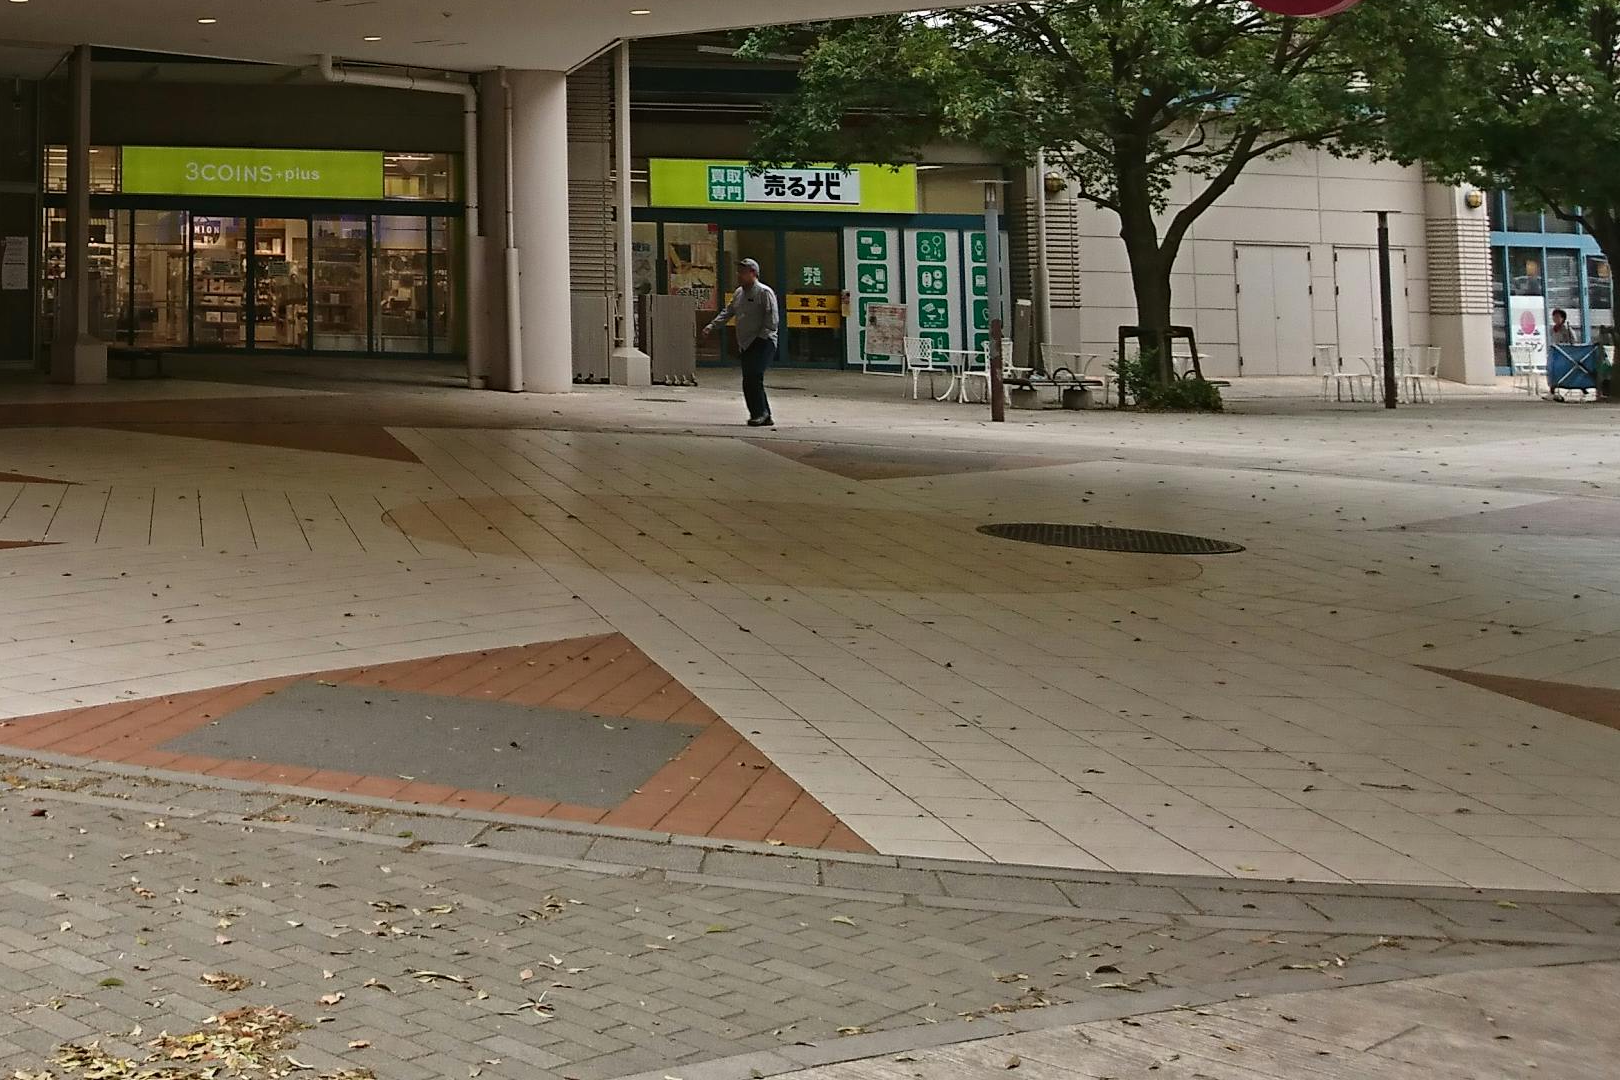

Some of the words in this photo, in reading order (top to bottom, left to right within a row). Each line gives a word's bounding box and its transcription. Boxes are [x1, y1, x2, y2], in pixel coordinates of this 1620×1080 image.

[710, 168, 742, 183] 買取
[711, 185, 742, 201] 専門
[764, 172, 841, 201] 売るナビ
[800, 297, 827, 308] 査定
